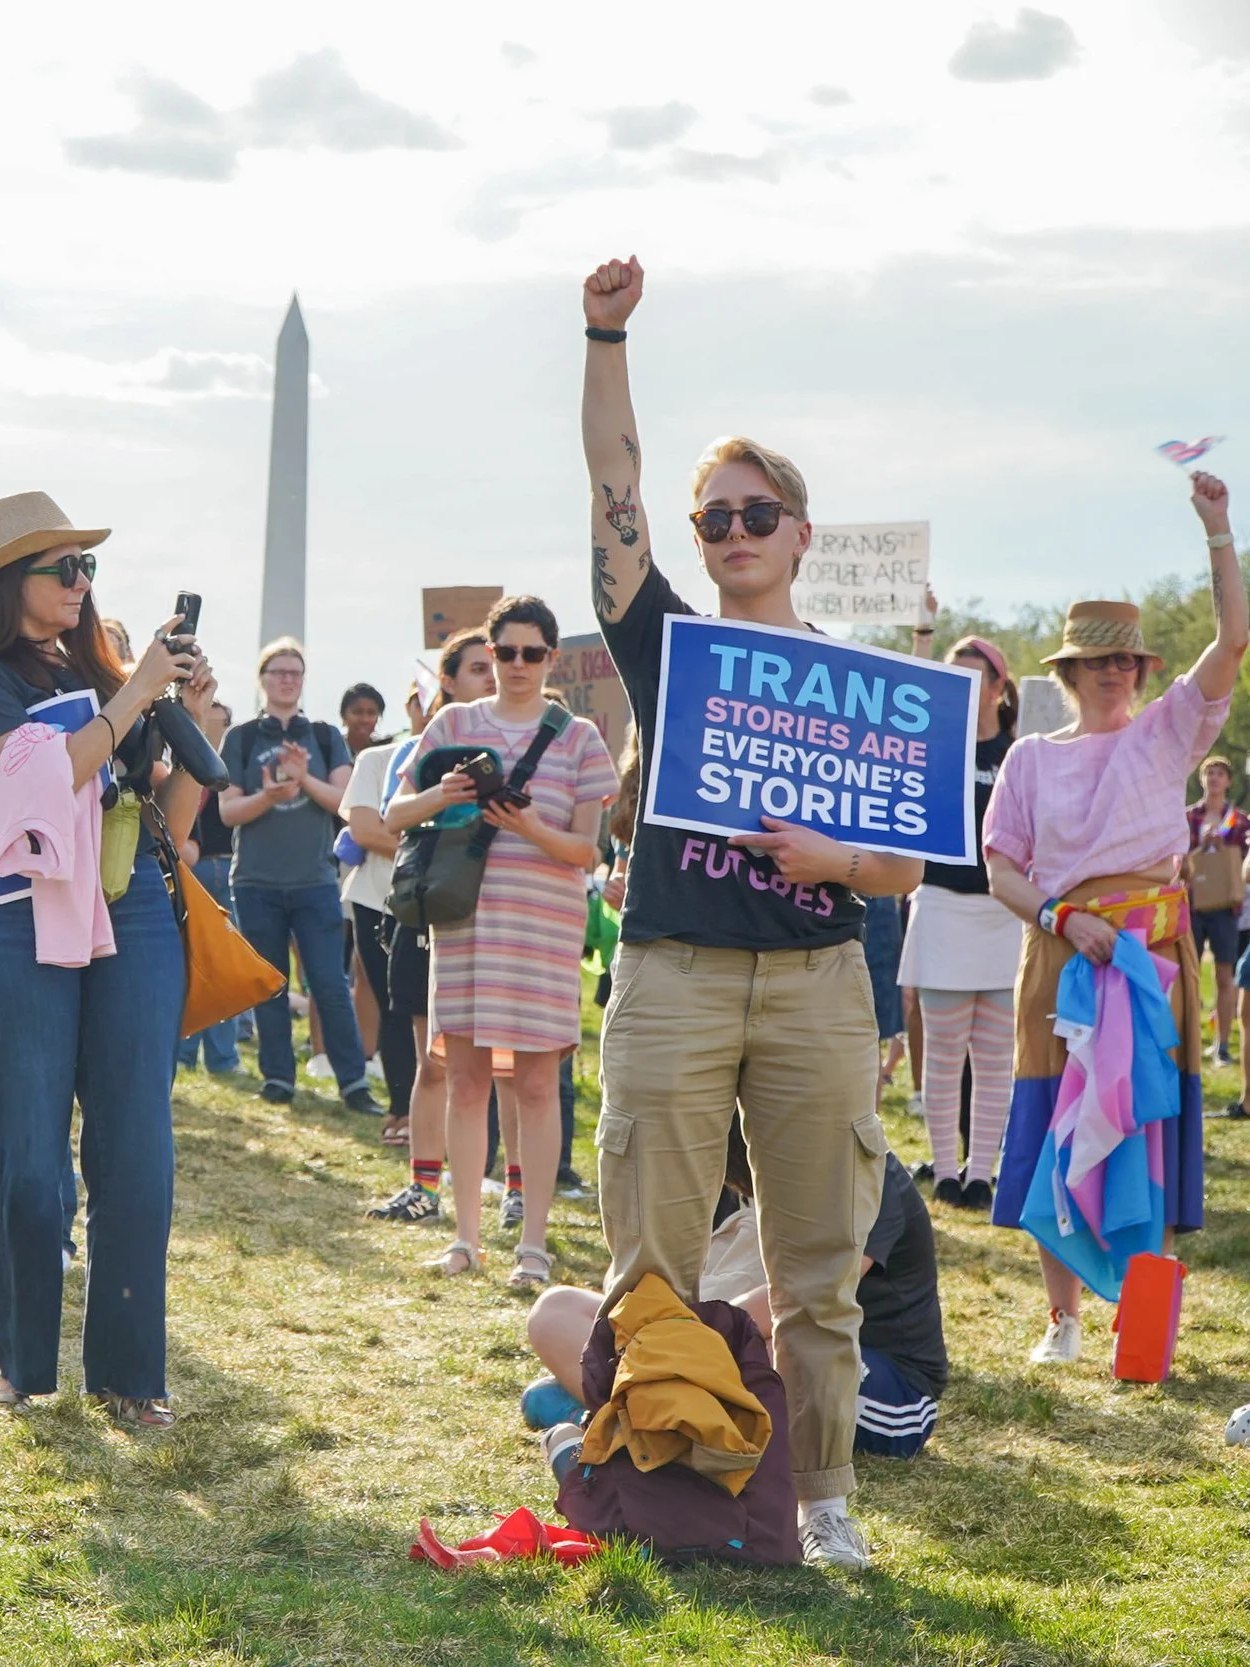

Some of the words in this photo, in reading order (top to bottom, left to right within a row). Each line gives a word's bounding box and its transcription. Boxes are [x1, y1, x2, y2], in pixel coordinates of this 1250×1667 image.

[709, 643, 931, 734] TRANS
[702, 727, 926, 798] EVERYONE'S
[705, 696, 850, 751] STORIES
[858, 731, 927, 767] ARE
[696, 762, 928, 836] STORIES
